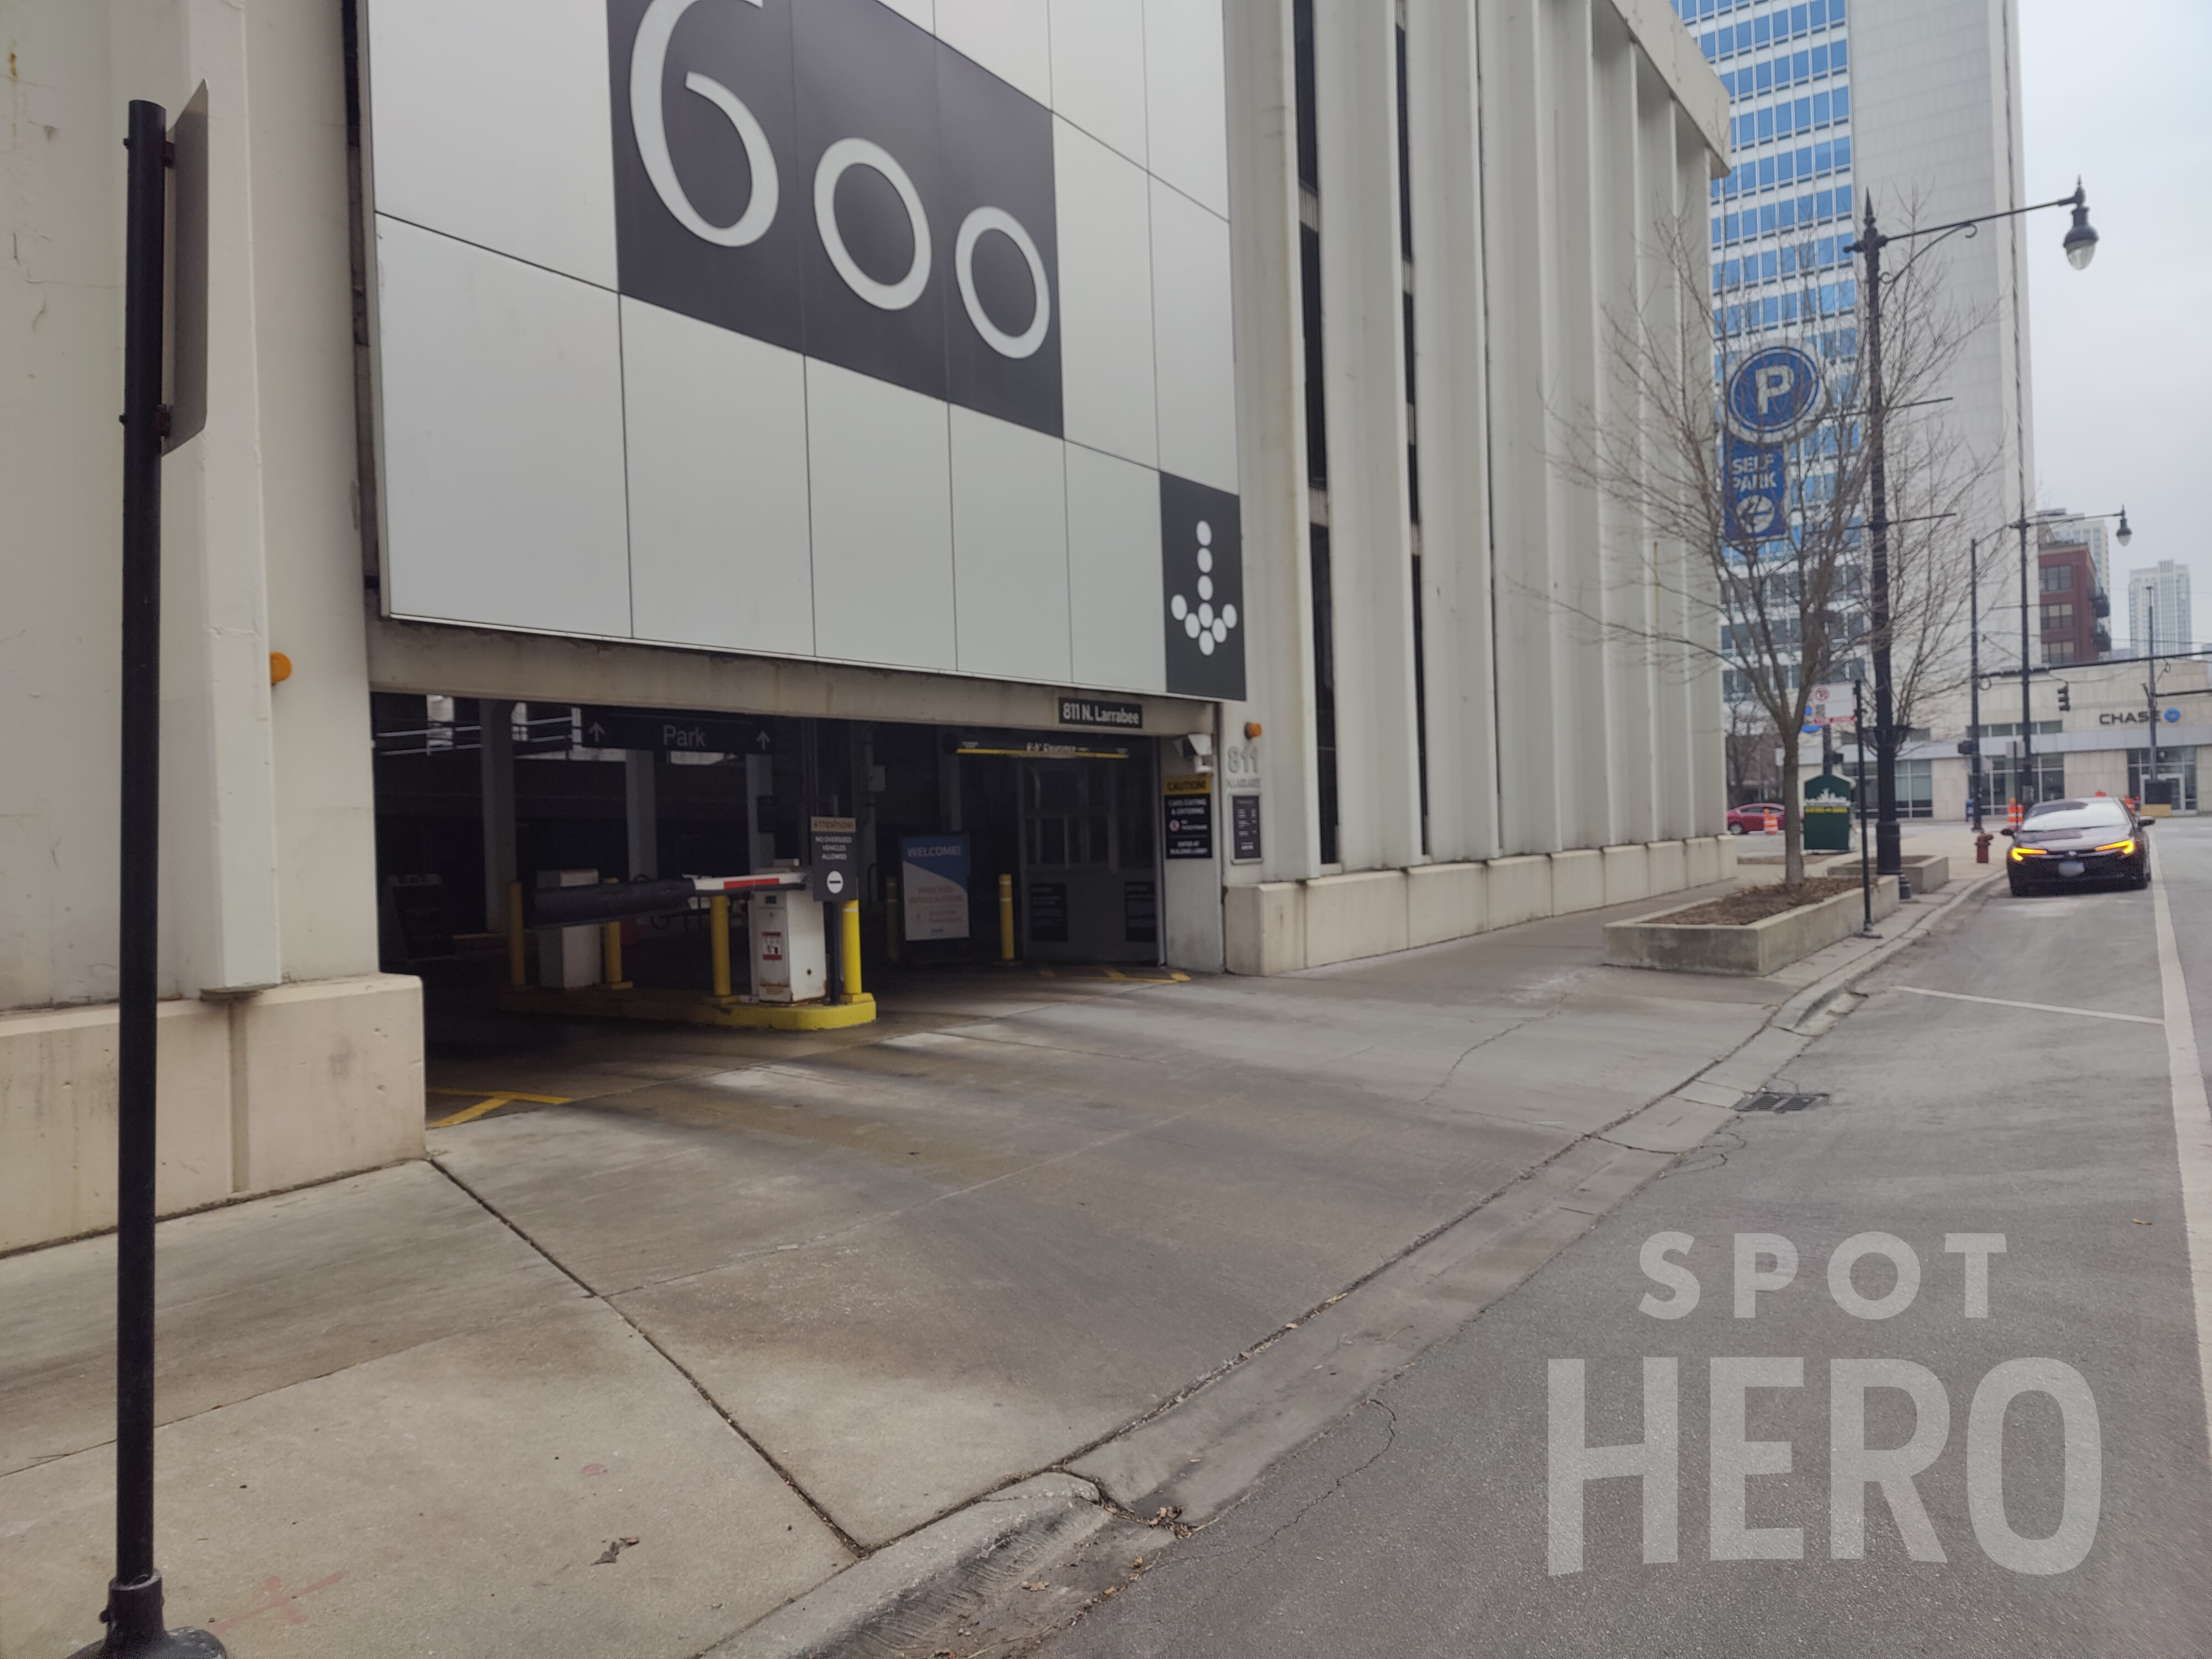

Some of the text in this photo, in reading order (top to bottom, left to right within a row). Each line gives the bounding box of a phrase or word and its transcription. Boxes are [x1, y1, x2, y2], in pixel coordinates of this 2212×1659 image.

[630, 0, 1050, 359] 600
[1755, 365, 1794, 415] P
[1732, 453, 1774, 475] SELF
[1063, 702, 1140, 725] 811 N. Larrabee
[663, 725, 706, 747] Park
[1228, 745, 1258, 774] 811
